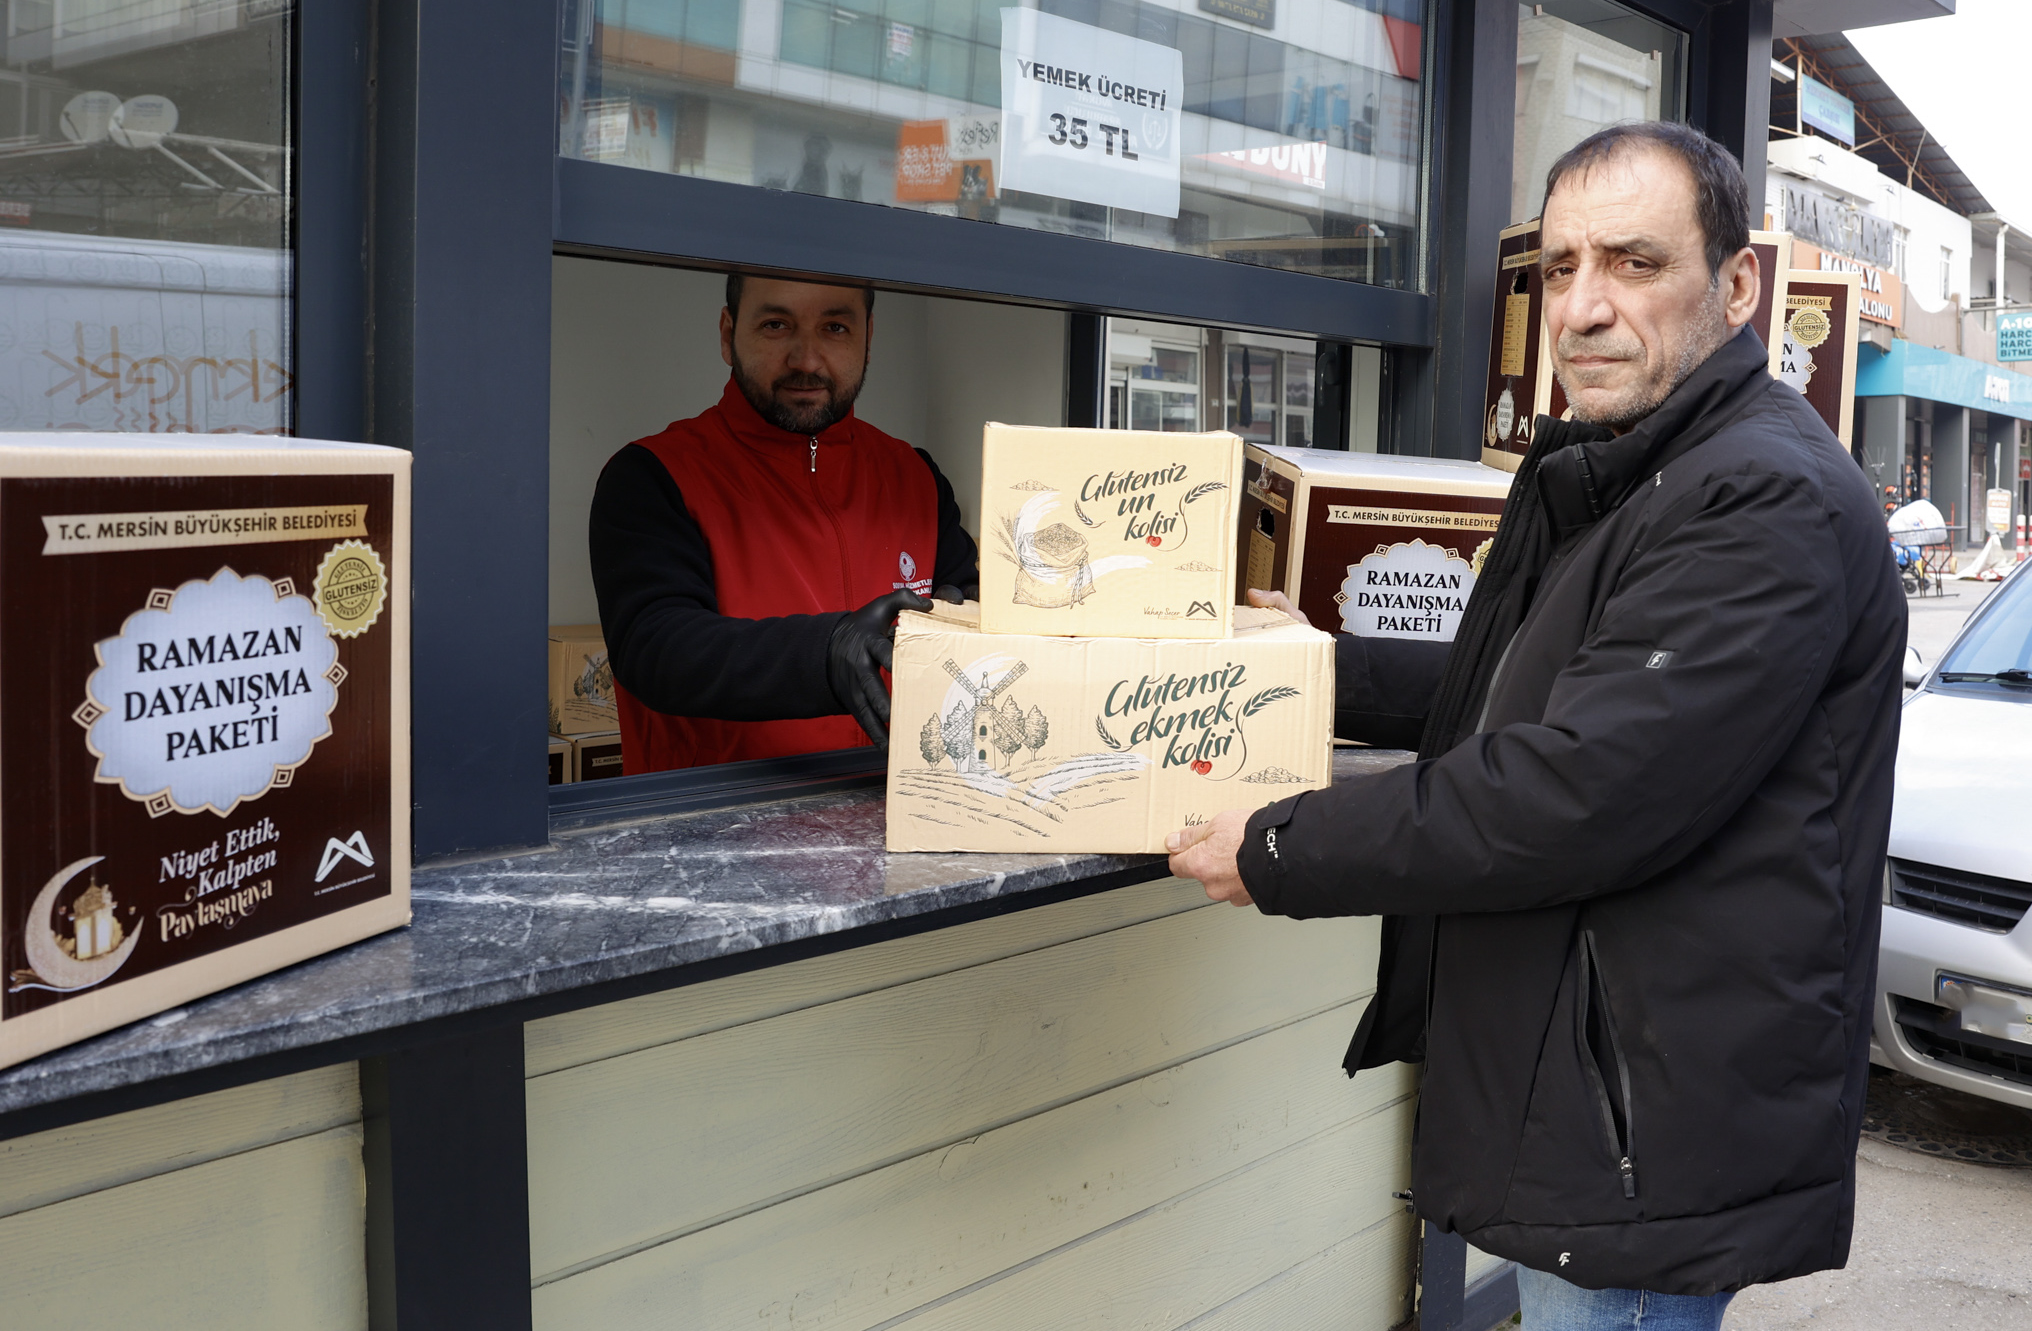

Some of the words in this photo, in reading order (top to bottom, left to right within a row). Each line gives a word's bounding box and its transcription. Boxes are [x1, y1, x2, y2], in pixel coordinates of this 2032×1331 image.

[1017, 58, 1091, 93] YEMEK
[1097, 75, 1166, 111] ÜCRETİ
[1048, 112, 1089, 150] 35
[1099, 123, 1139, 161] TL
[1859, 298, 1893, 321] ALONU
[59, 524, 91, 540] T.C.
[97, 515, 168, 540] MERSİN
[174, 511, 277, 538] BÜYÜKŞEHİR
[283, 509, 357, 531] BELEDİYESİ
[1117, 493, 1155, 516] un
[1334, 510, 1350, 519] T.C.
[1352, 510, 1389, 522] MERSİN
[1392, 511, 1451, 526] BÜYÜKŞEHİR
[1454, 516, 1500, 528] BELEDİYES
[1124, 511, 1179, 541] kolisi
[325, 578, 377, 601] GLUTENSİZ
[1366, 570, 1461, 589] RAMAZAN
[1357, 592, 1464, 617] DAYANIŞMA
[1377, 613, 1442, 633] PAKETİ
[137, 625, 302, 673] RAMAZAN
[124, 667, 312, 722] DAYANIŞMA
[166, 705, 278, 762] PAKETİ
[1130, 689, 1234, 746] ekmek
[1162, 727, 1236, 769] kolisi
[158, 840, 220, 883] Niyet
[225, 817, 280, 858] Ettik,
[197, 849, 277, 897] Kalpten
[159, 879, 274, 942] Paylaşmaya
